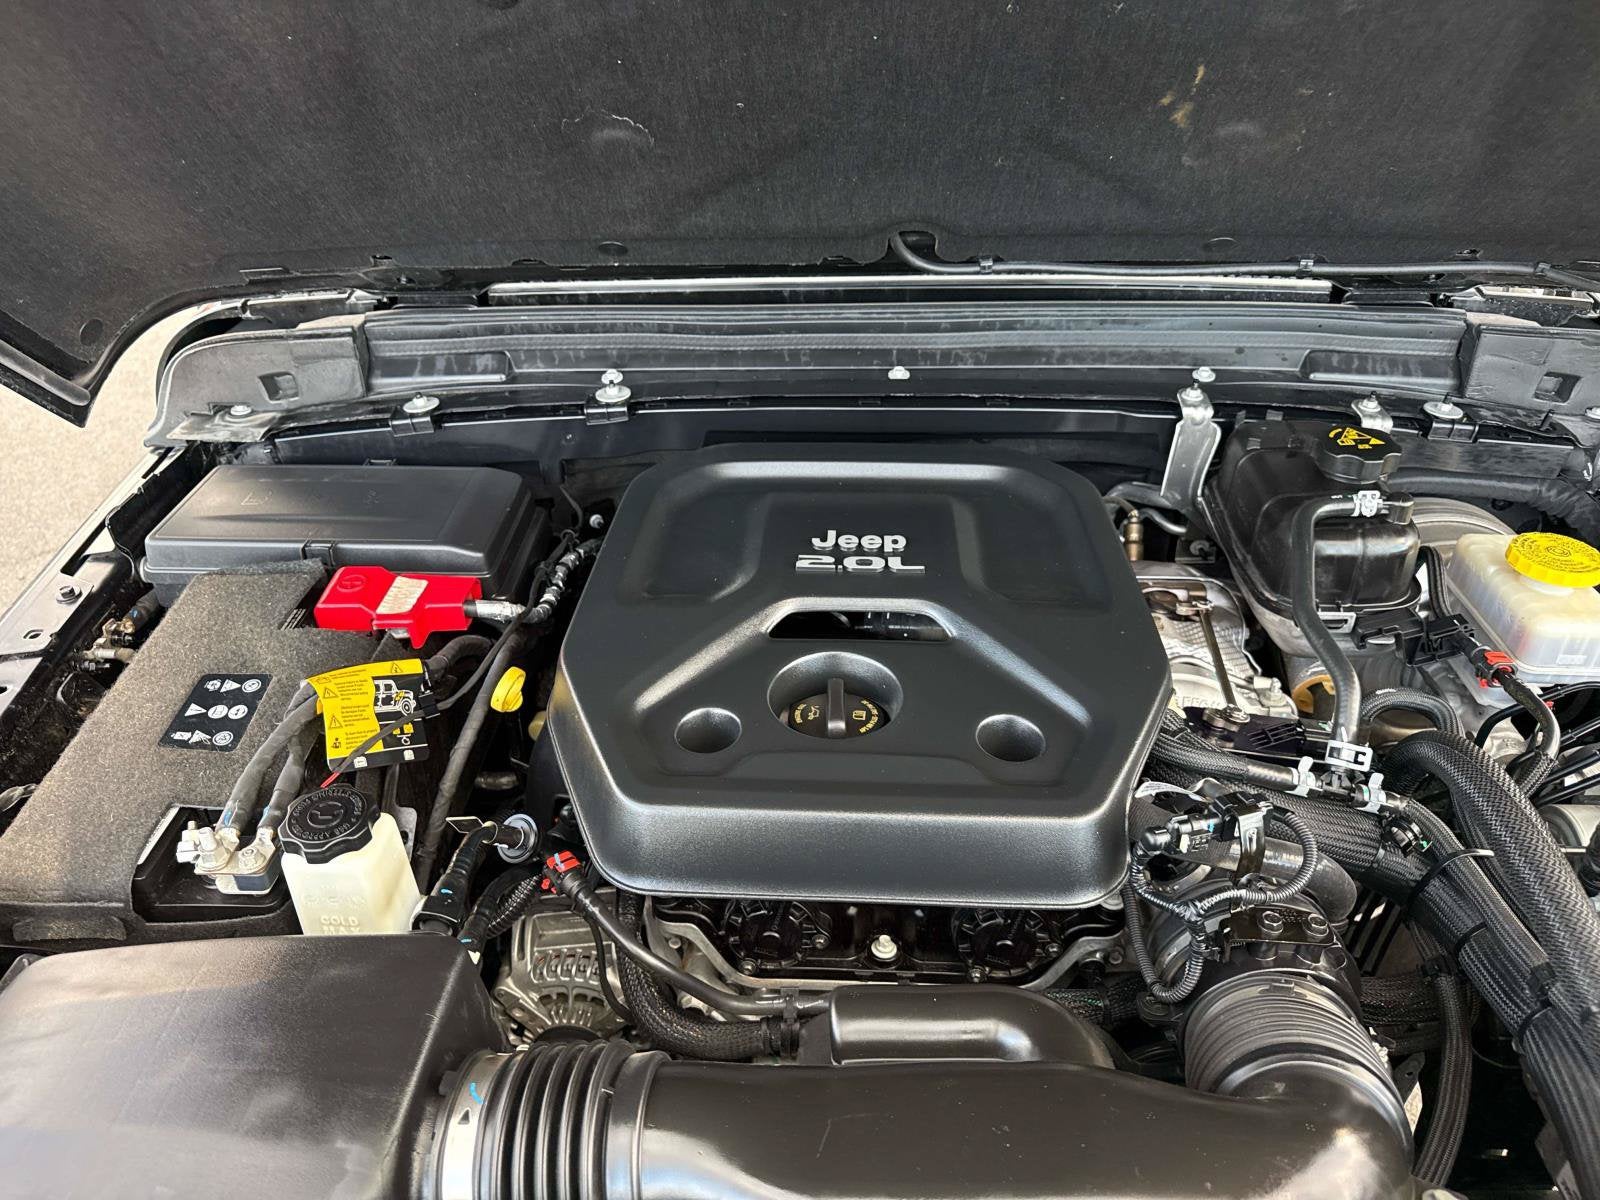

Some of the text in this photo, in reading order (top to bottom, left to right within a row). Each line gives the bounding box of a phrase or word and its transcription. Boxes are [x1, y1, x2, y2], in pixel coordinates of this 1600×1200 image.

[811, 529, 907, 553] Jeep
[795, 554, 926, 573] 2.0L
[320, 915, 359, 927] COLD
